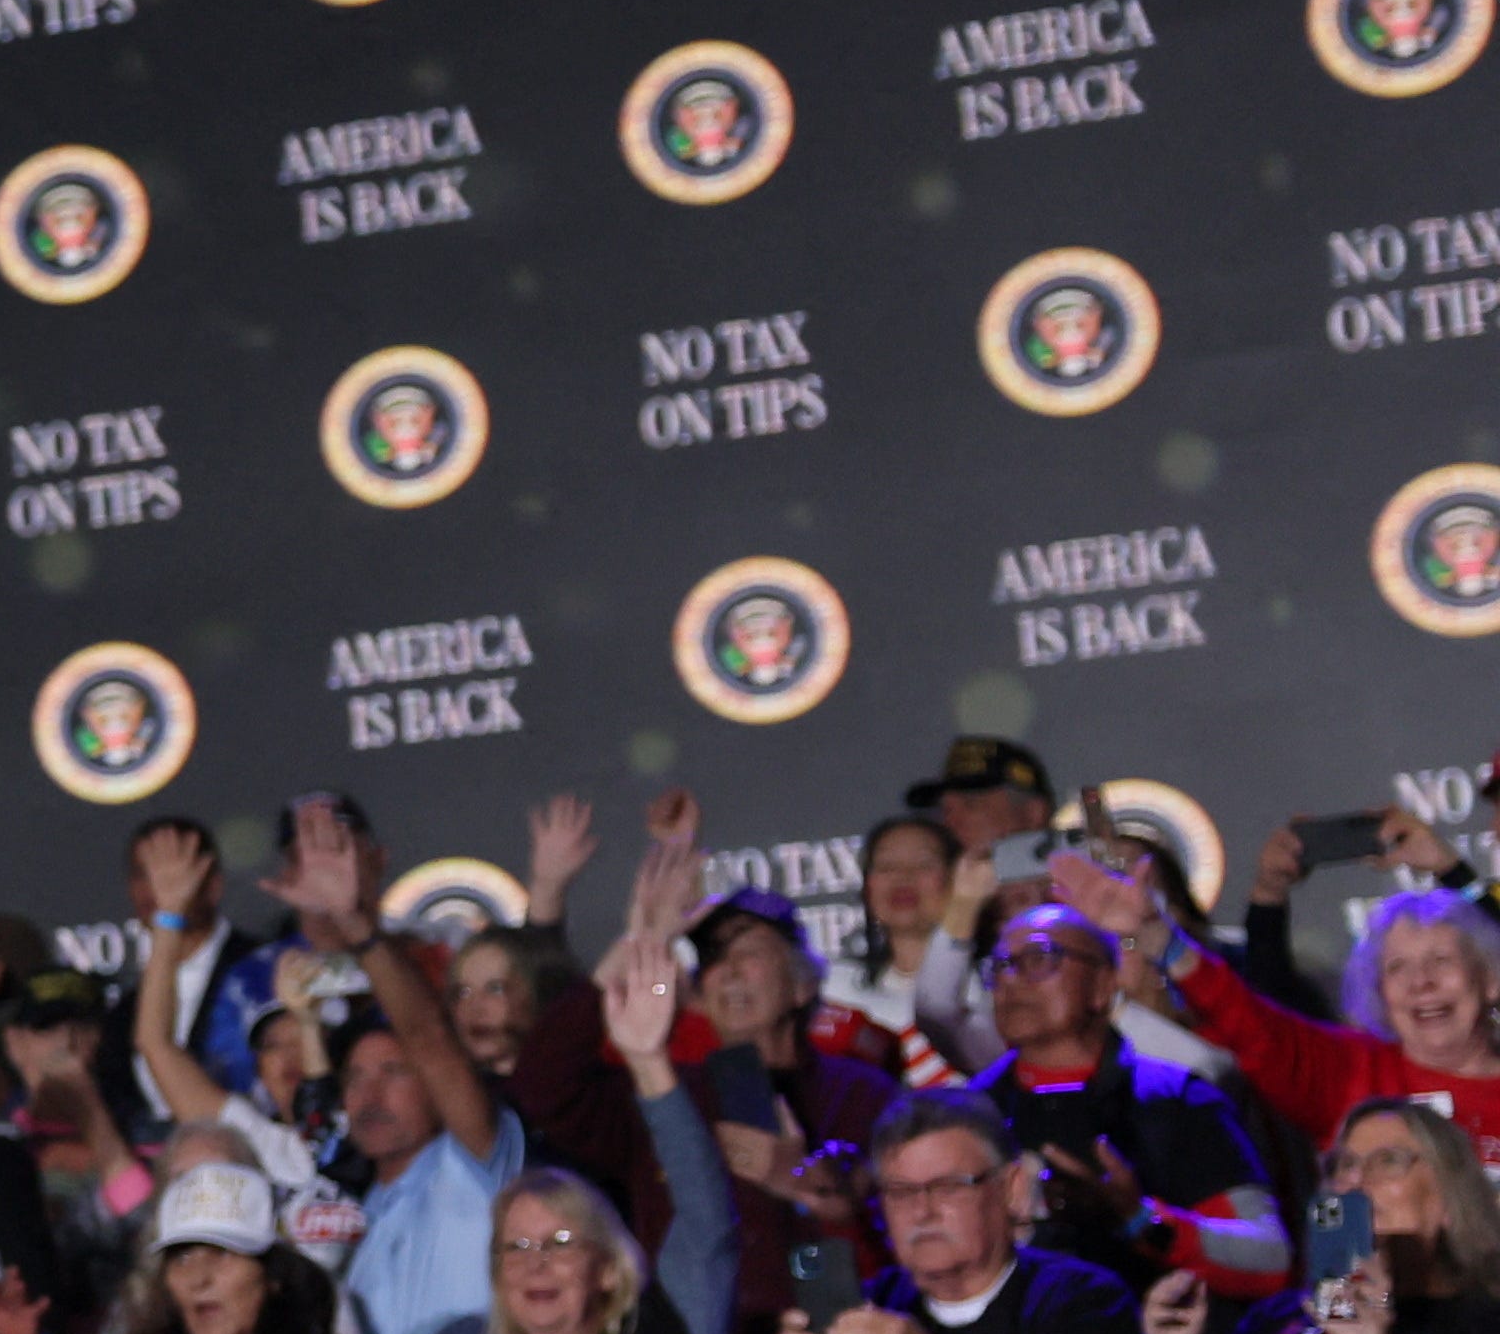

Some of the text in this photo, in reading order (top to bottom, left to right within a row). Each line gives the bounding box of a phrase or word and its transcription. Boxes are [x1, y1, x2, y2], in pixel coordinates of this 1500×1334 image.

[957, 59, 1144, 141] IS BACK
[281, 107, 482, 183] AMERICA
[299, 166, 472, 244] IS BACK
[1327, 223, 1408, 287] NO
[640, 310, 810, 386] NO TAX
[1326, 277, 1500, 352] ON TIP
[9, 406, 166, 476] NO TAX
[638, 372, 828, 448] ON TIPS
[6, 465, 181, 536] ON TIPS
[996, 526, 1216, 602] AMERICA
[328, 614, 533, 690] AMERICA
[1016, 590, 1205, 667] IS BACK
[347, 676, 522, 751] IS BACK
